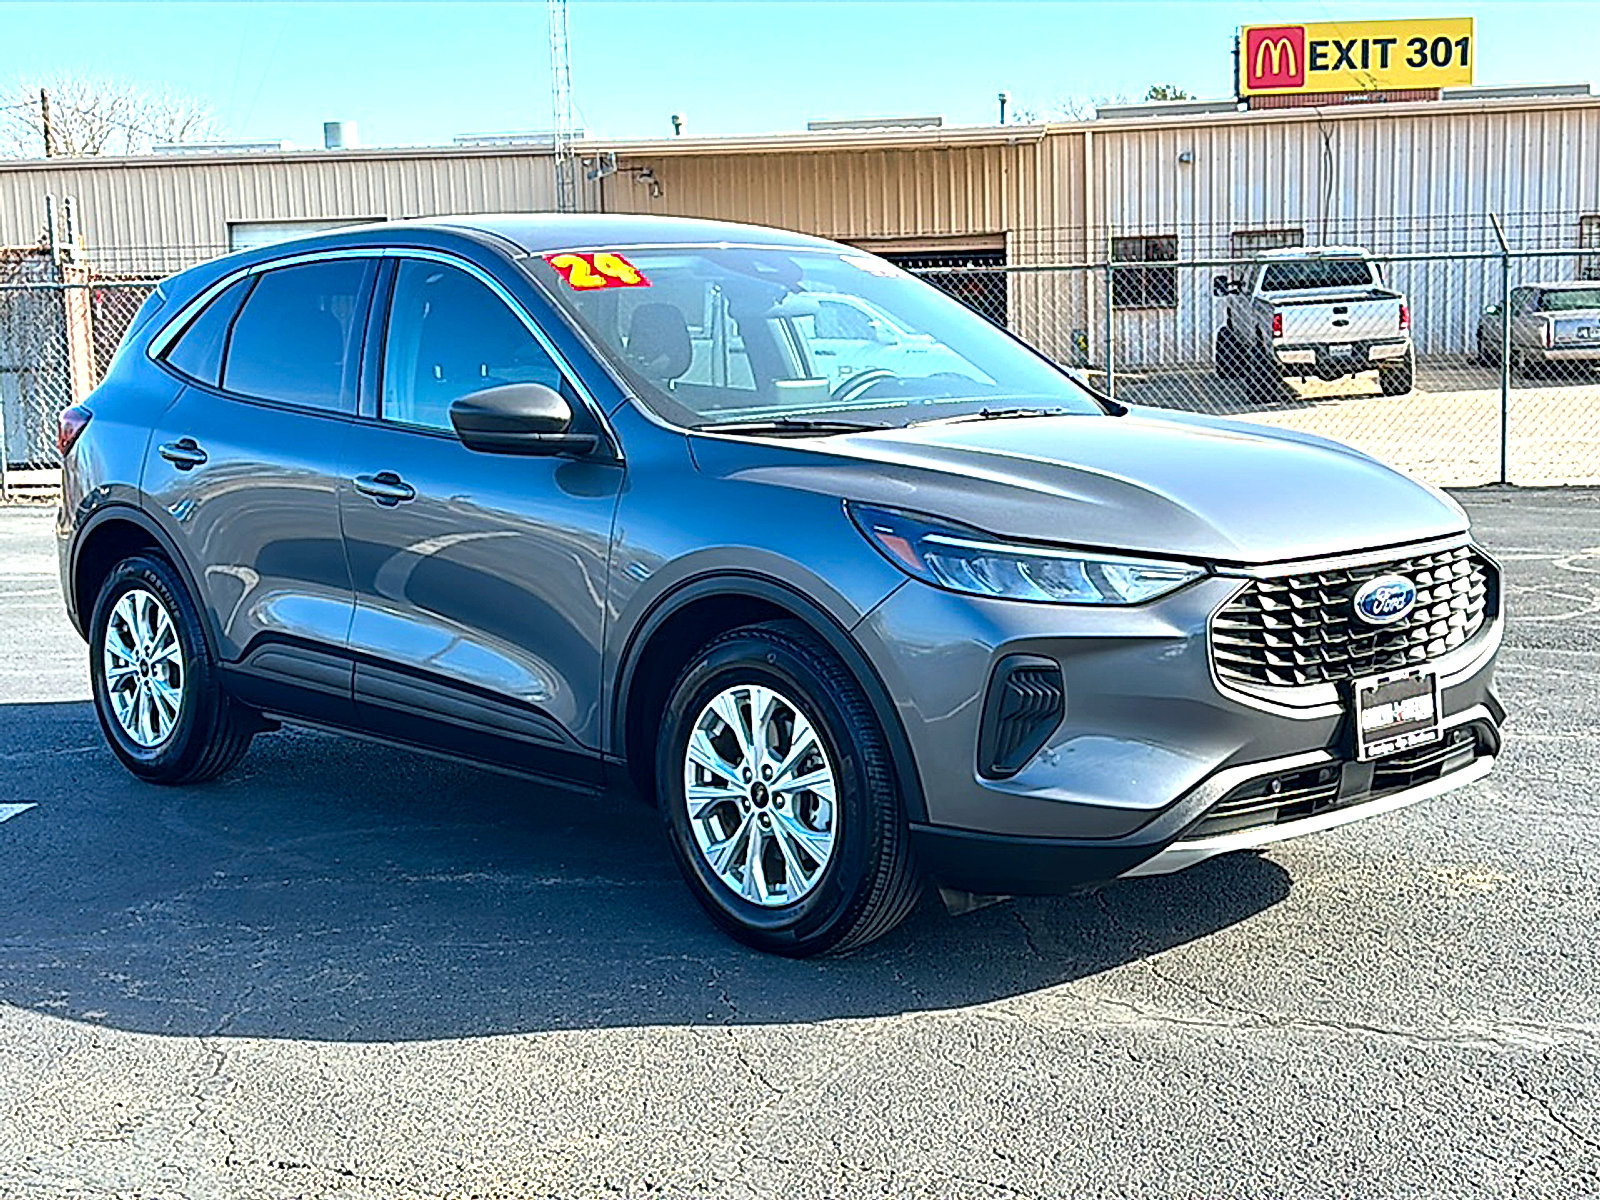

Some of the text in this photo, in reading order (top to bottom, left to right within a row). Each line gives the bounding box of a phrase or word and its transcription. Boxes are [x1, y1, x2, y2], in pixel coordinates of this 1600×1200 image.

[1309, 36, 1470, 71] EXIT 301
[550, 253, 641, 288] 24
[1372, 586, 1407, 615] Ford
